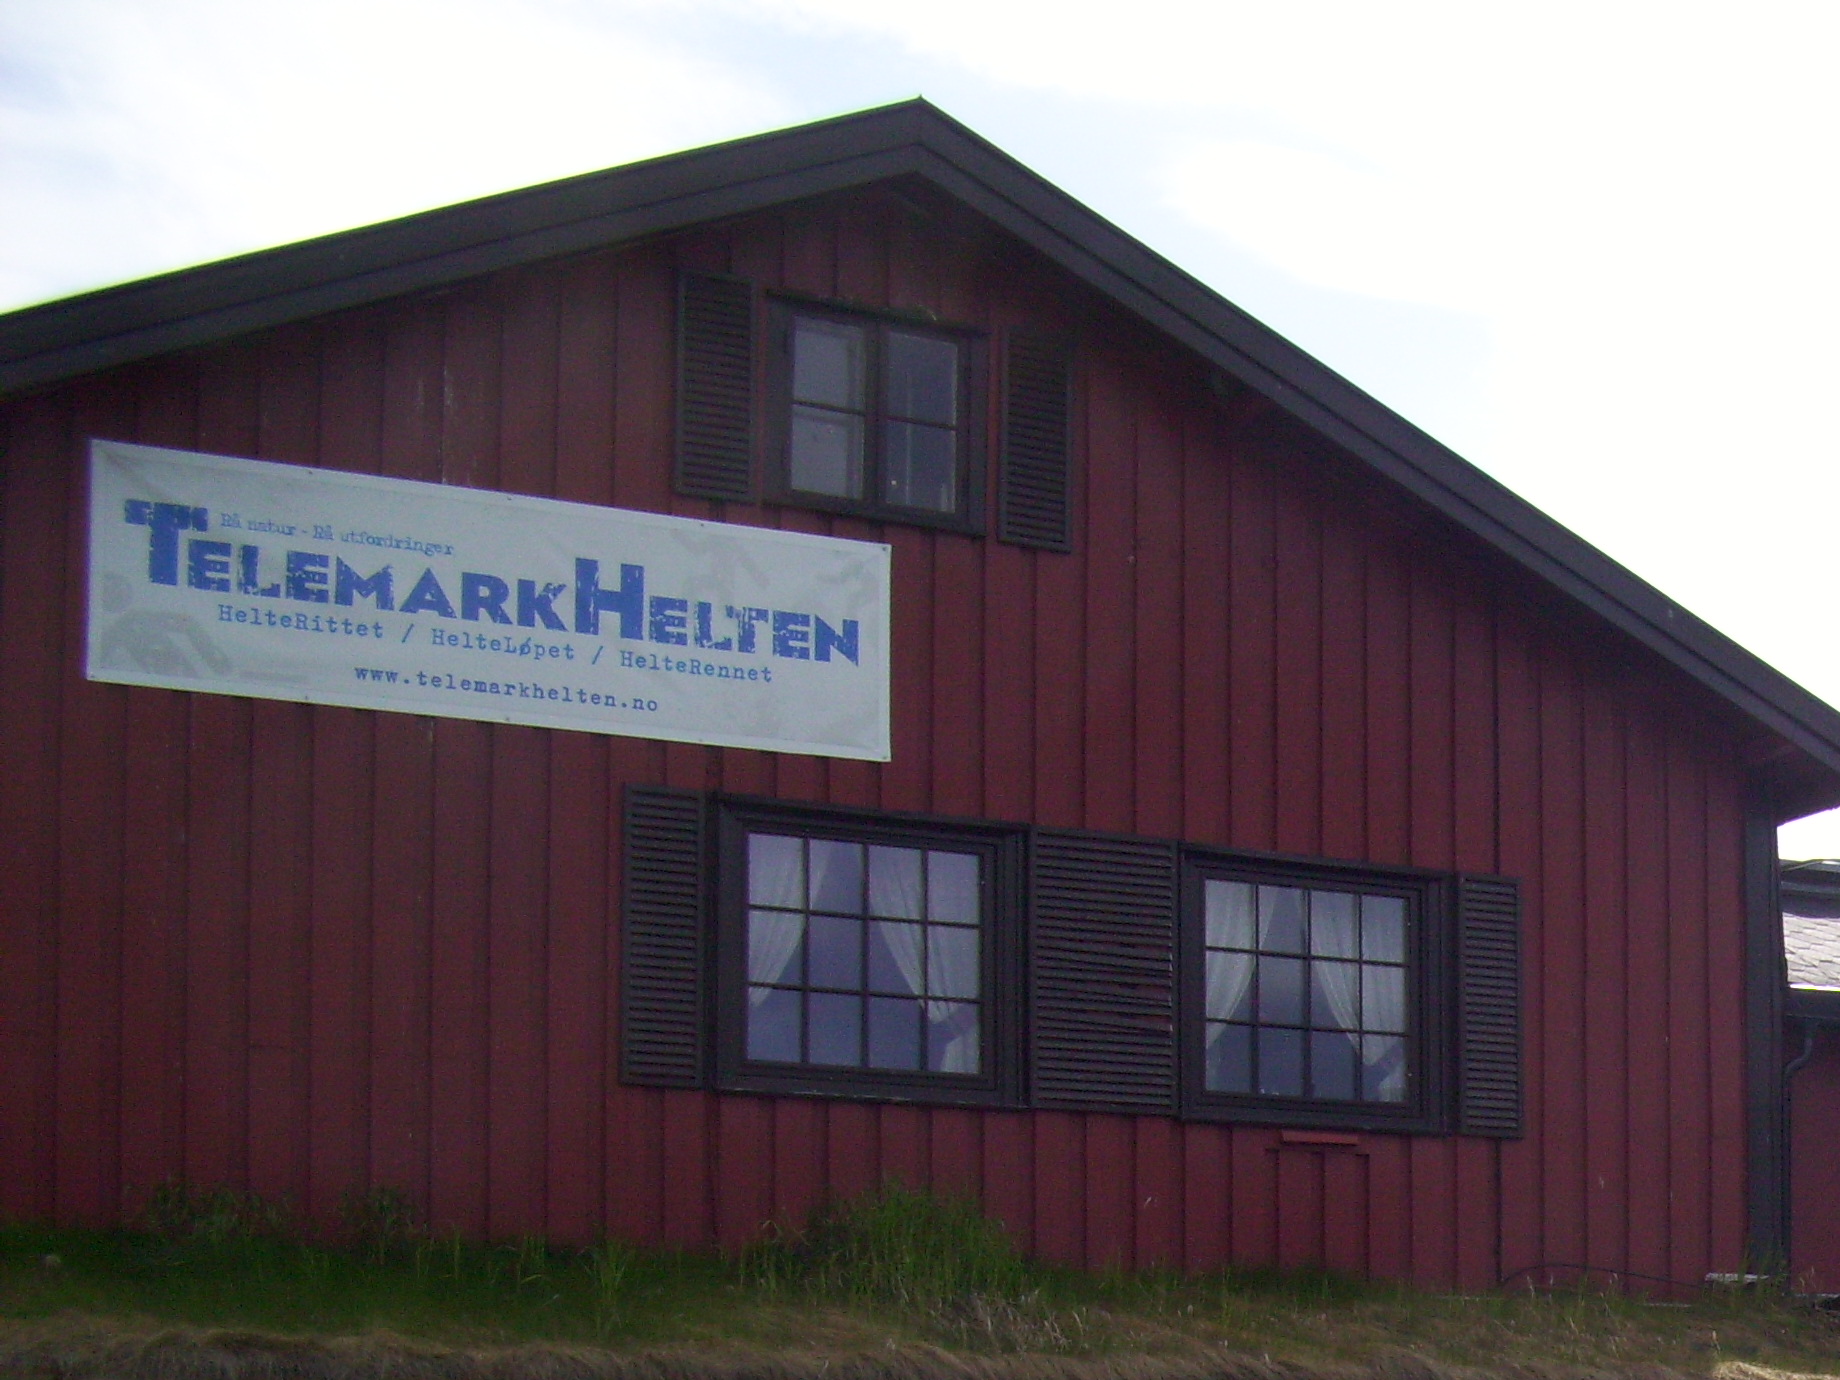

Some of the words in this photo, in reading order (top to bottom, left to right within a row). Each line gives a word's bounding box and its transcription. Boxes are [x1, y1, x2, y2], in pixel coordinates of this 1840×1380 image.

[220, 512, 241, 529] Rå
[248, 518, 297, 536] natur
[313, 524, 335, 541] Rå
[341, 531, 455, 558] utfordringer
[217, 604, 384, 640] HelteRittet
[431, 628, 576, 663] HelteLøpet
[620, 649, 774, 684] HelteRennet
[354, 666, 659, 713] www.telemarkhelten.no
